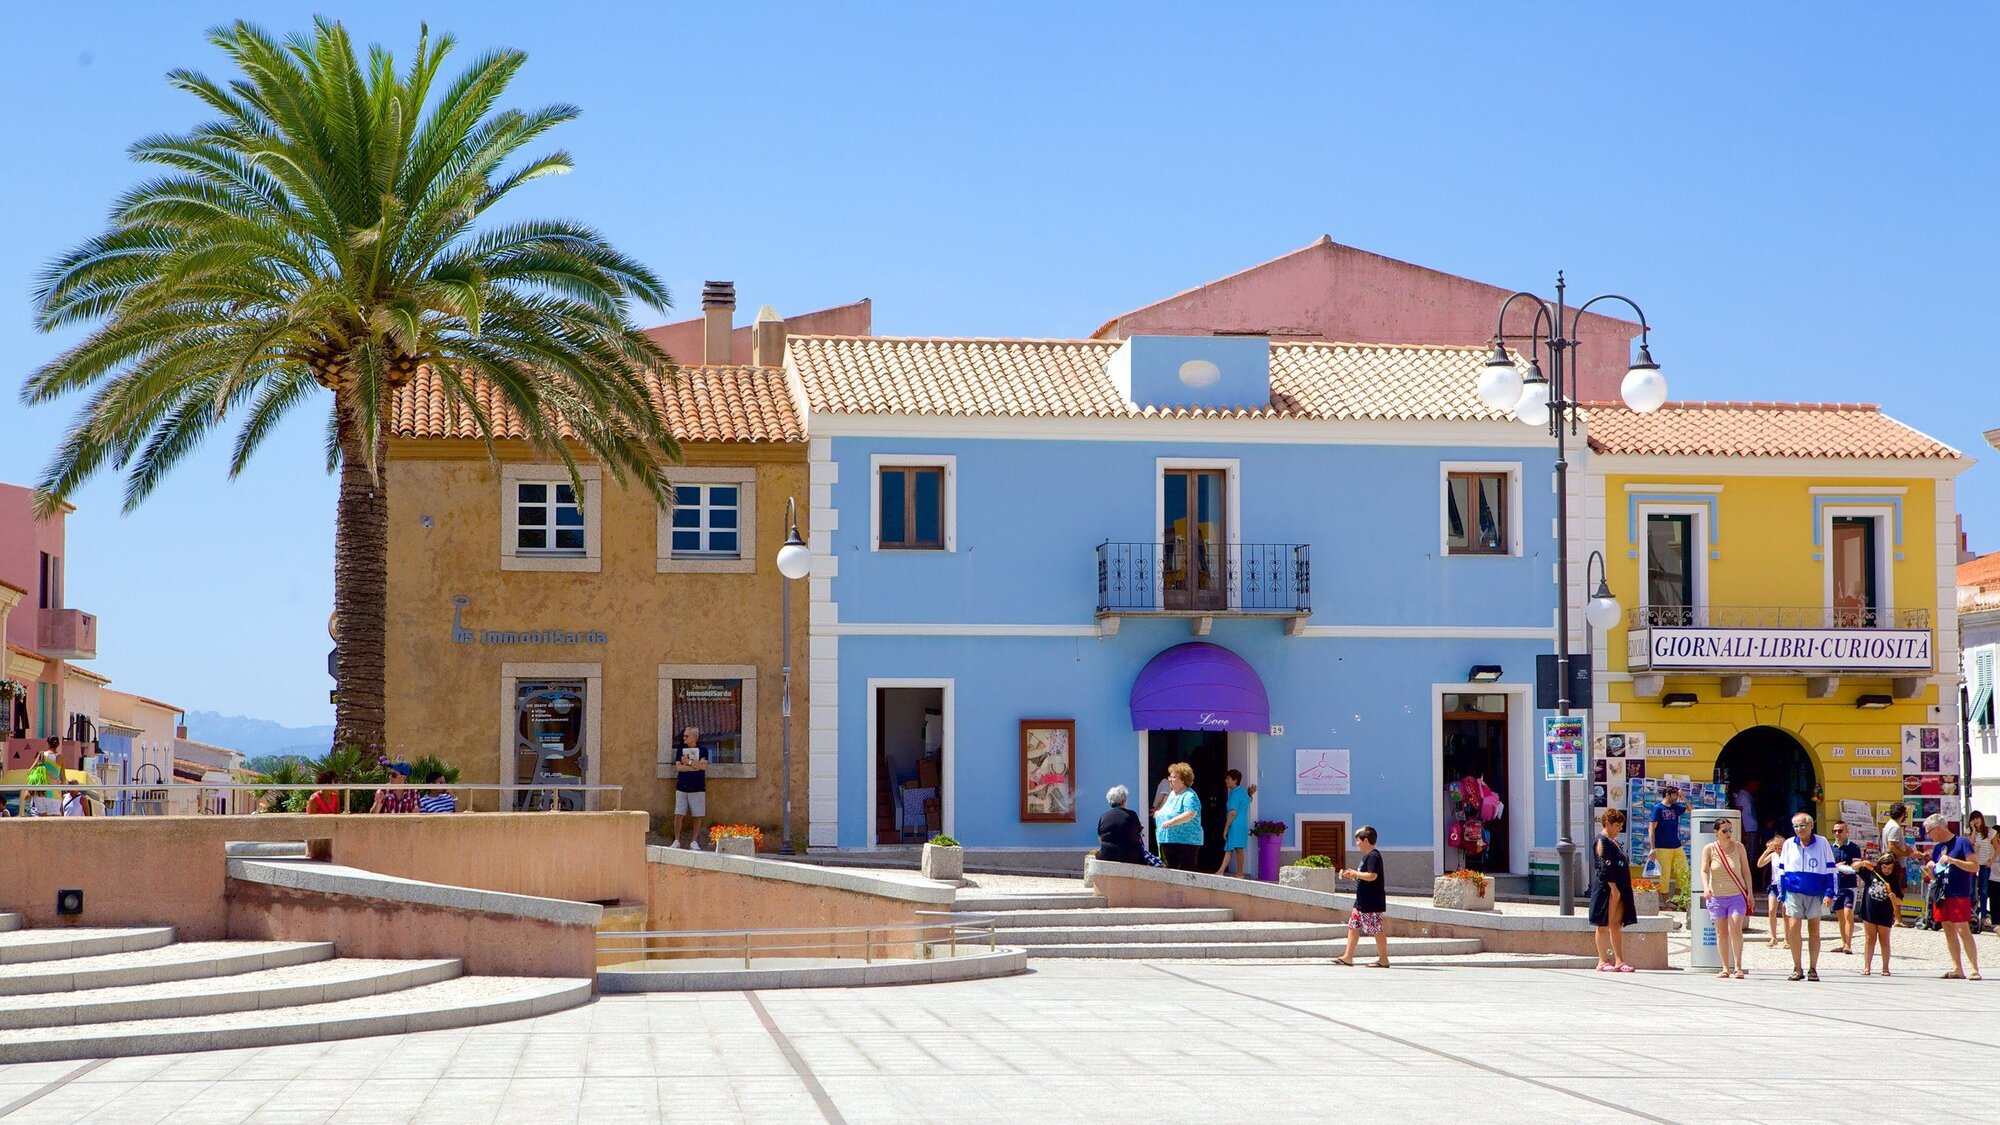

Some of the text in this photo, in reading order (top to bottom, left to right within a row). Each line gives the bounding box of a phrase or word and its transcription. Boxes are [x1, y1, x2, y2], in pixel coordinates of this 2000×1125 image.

[1197, 712, 1230, 726] Love
[1273, 726, 1283, 734] 29
[1834, 748, 1844, 756] 30
[1857, 748, 1891, 756] EDICOLA
[1852, 768, 1897, 776] LIBRI DVD
